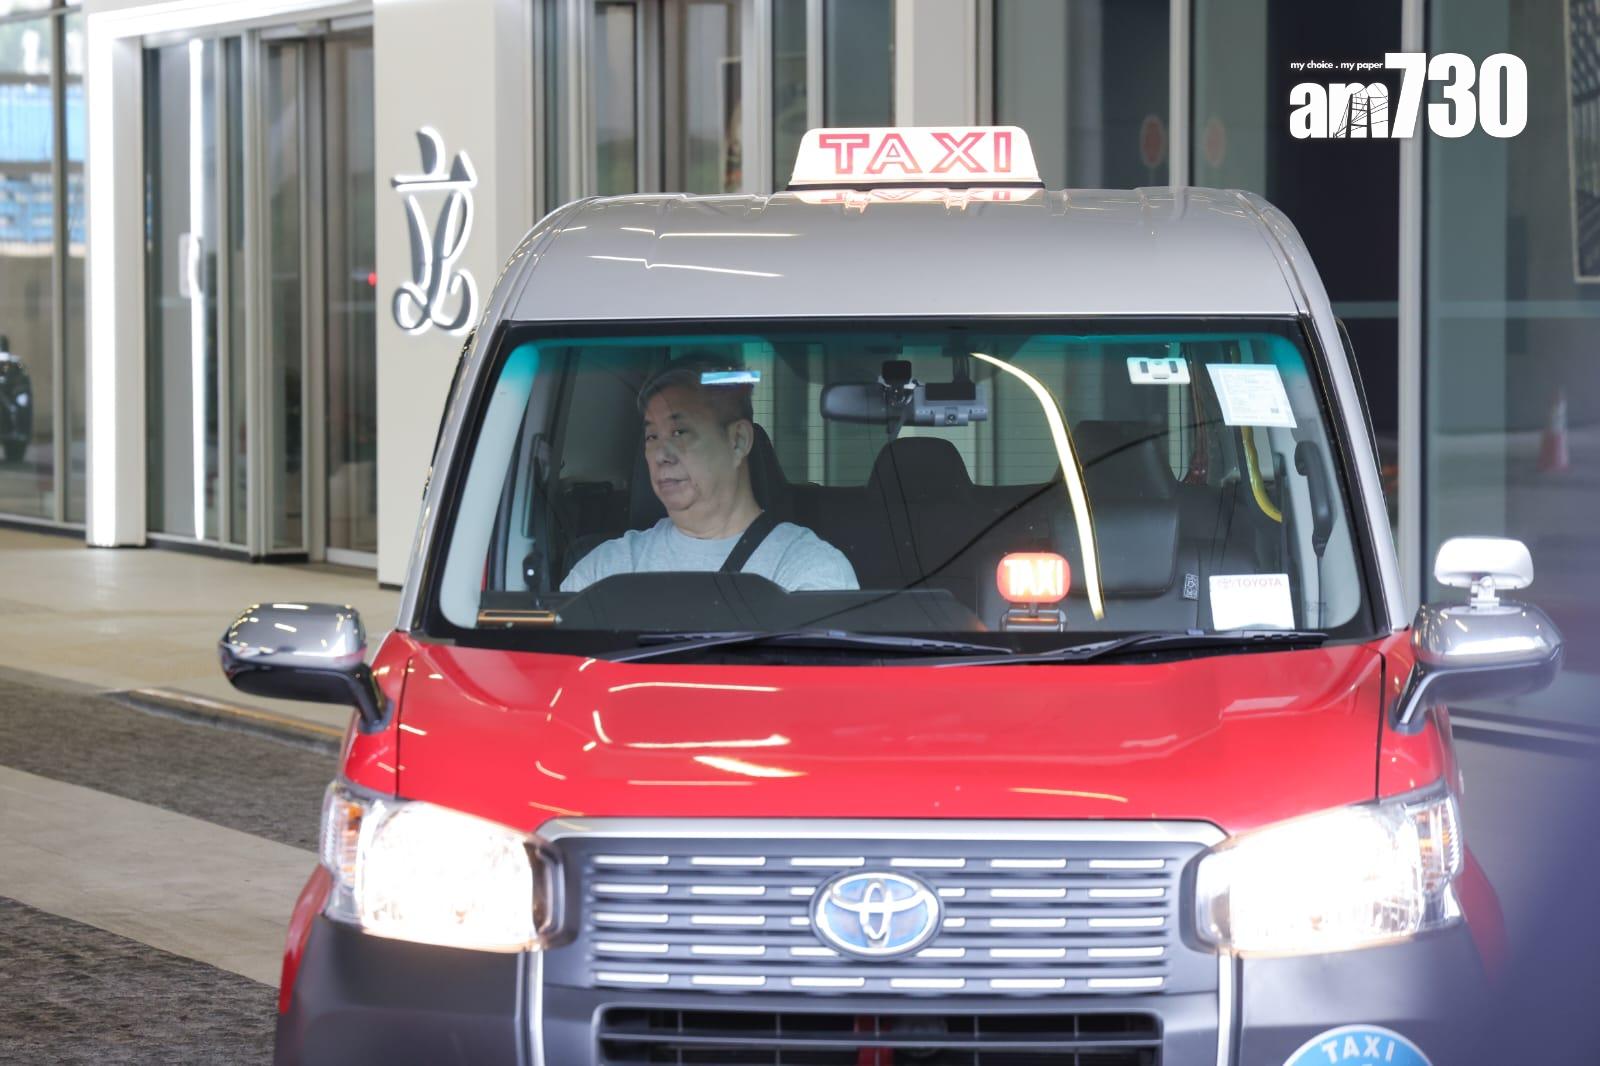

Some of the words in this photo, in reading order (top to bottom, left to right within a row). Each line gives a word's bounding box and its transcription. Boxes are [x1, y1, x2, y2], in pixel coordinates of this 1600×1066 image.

[819, 131, 1012, 175] TAXI
[1004, 559, 1063, 596] TAXI
[1236, 577, 1282, 588] TOYOTA
[1322, 1035, 1395, 1064] TAXI
